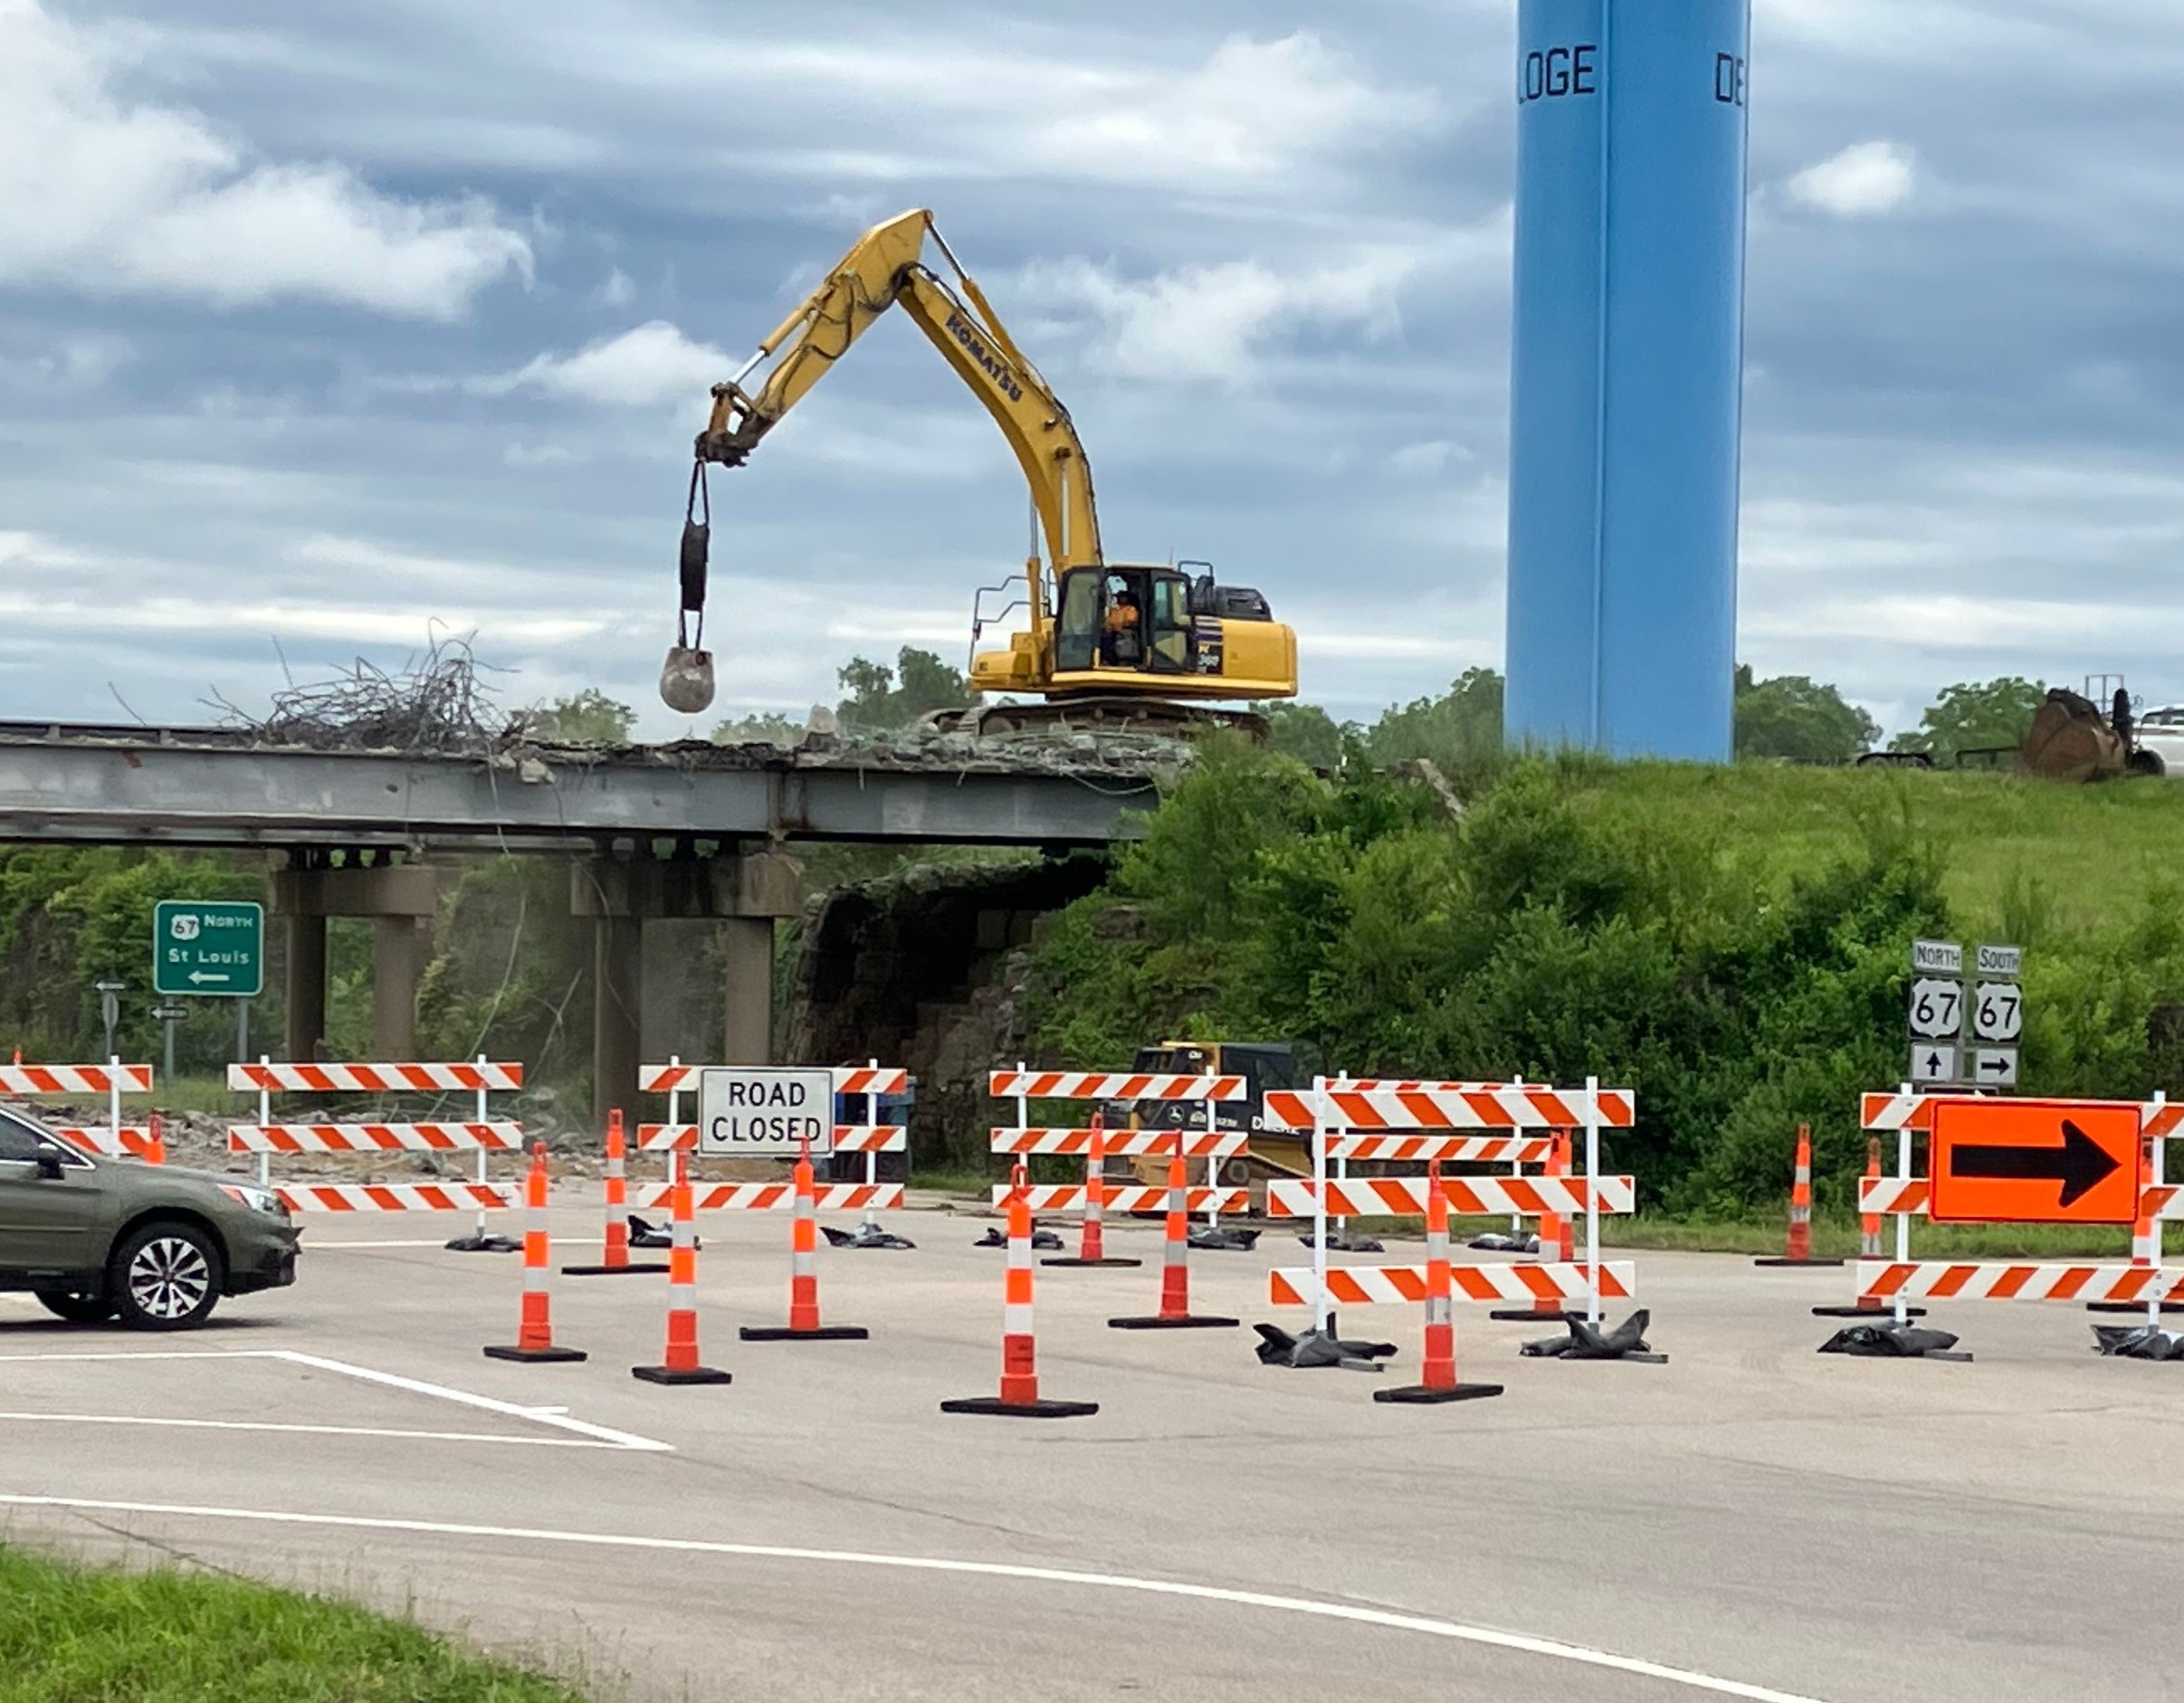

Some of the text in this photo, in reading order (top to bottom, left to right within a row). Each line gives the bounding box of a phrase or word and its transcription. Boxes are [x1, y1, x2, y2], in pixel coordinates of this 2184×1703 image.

[1520, 45, 1597, 104] OGE
[945, 313, 1023, 403] KOMATSU
[175, 919, 196, 935] 67
[168, 947, 250, 965] St Louis
[1916, 945, 1960, 966] NORTH
[1979, 948, 2018, 970] SOUTH
[1916, 993, 1957, 1026] 67
[1979, 996, 2017, 1030] 67
[730, 1082, 806, 1107] ROAD
[712, 1117, 821, 1142] CLOSED
